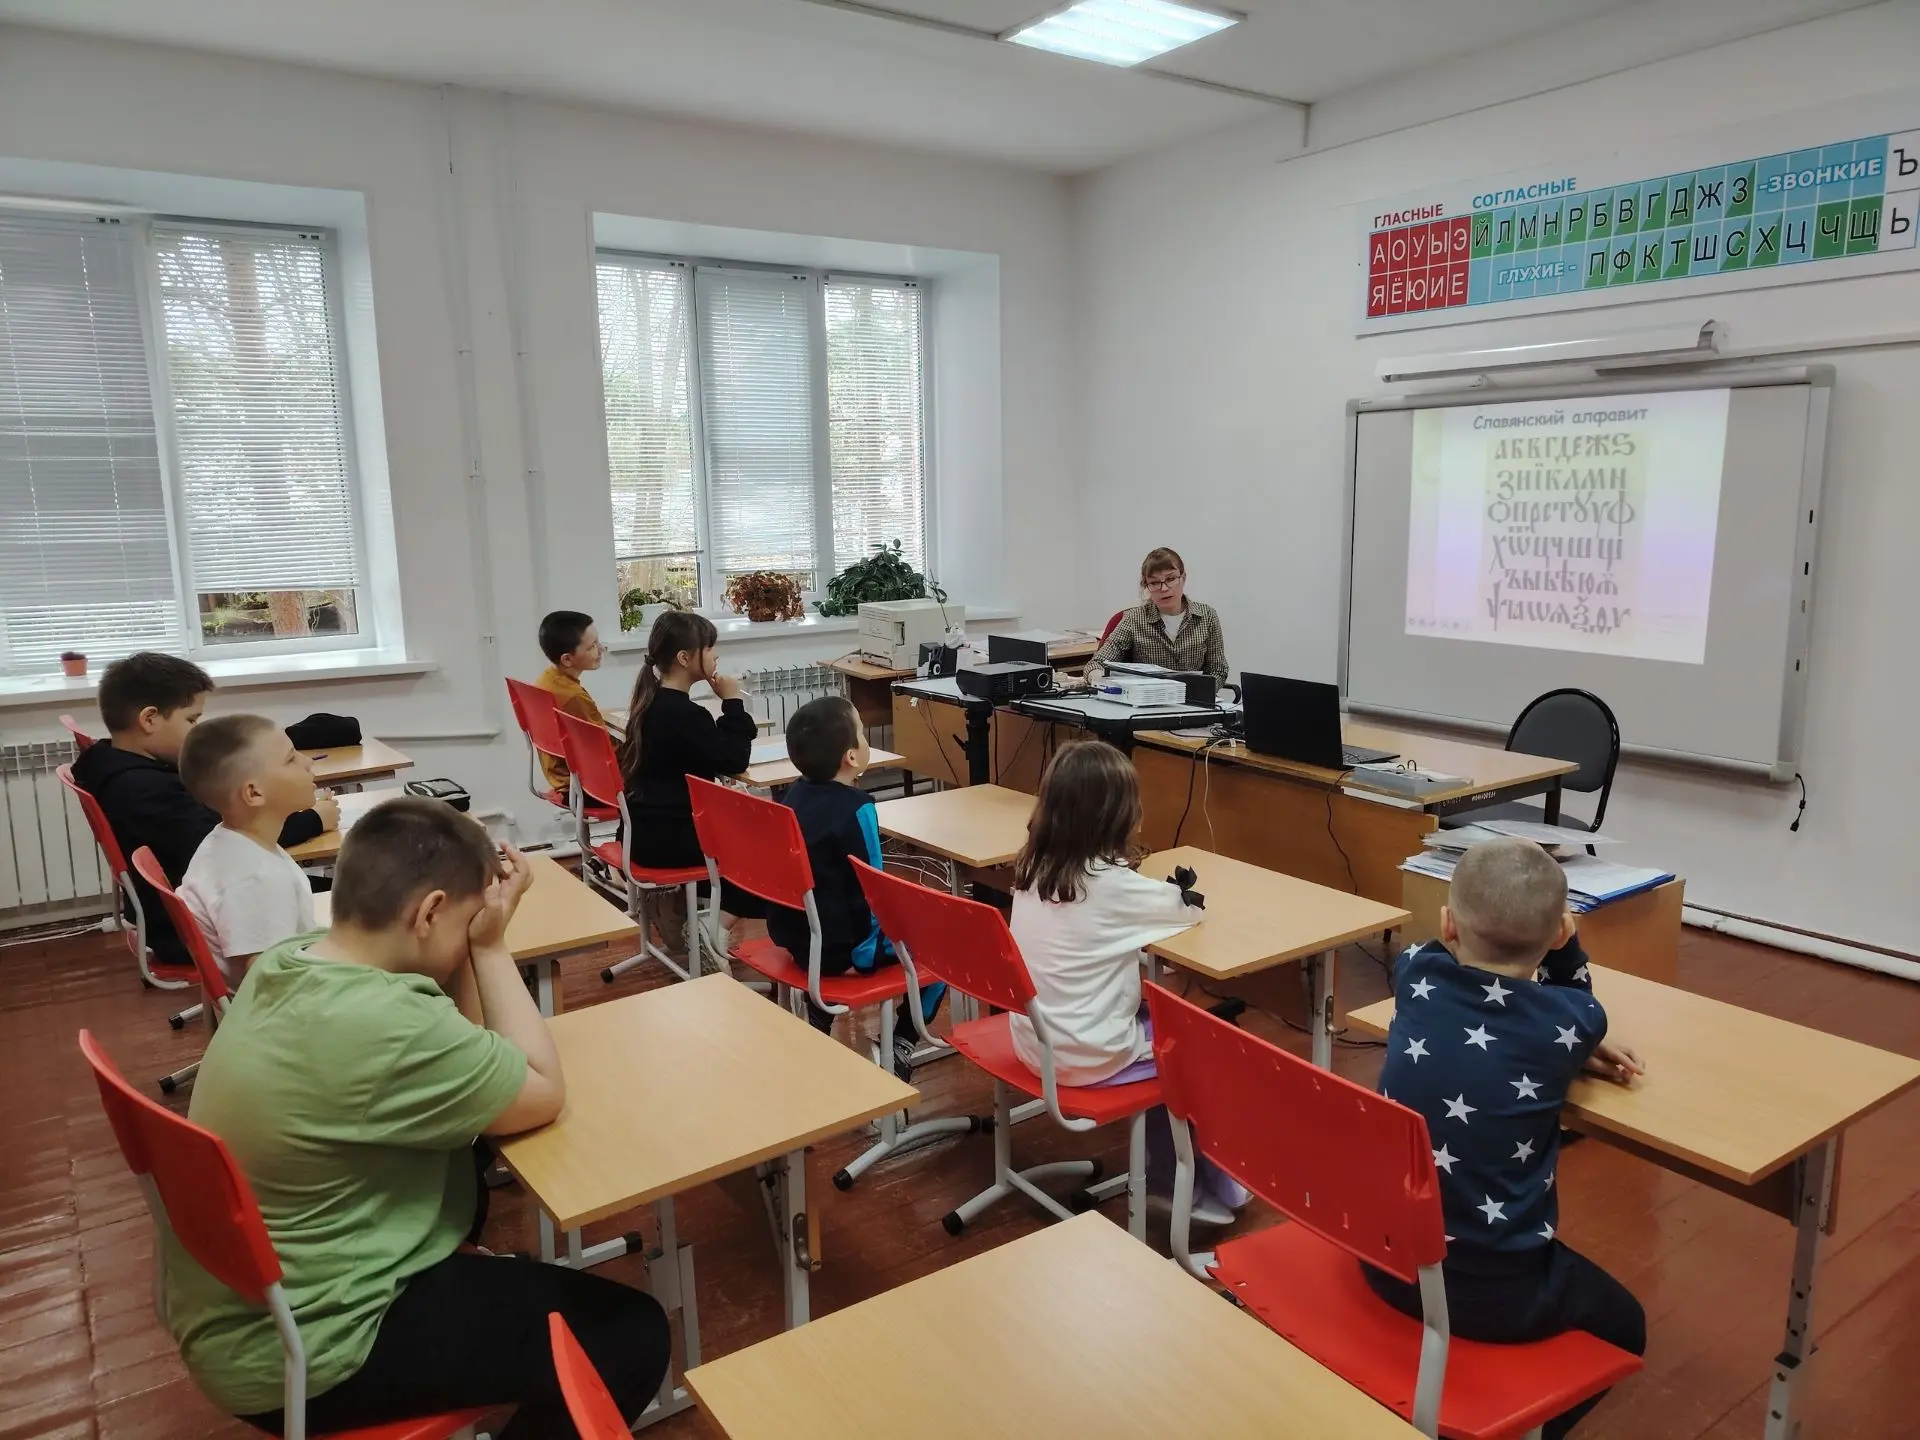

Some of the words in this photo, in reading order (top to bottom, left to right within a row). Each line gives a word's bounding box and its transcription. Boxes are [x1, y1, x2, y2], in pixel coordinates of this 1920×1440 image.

[1472, 177, 1577, 209] СОГЛАСНЫЕ
[1374, 204, 1443, 228] ГЛАСНЫЕ
[1498, 262, 1565, 285] ГЛУХИЕ
[1473, 409, 1564, 430] Славянский
[1572, 408, 1648, 428] алфавит
